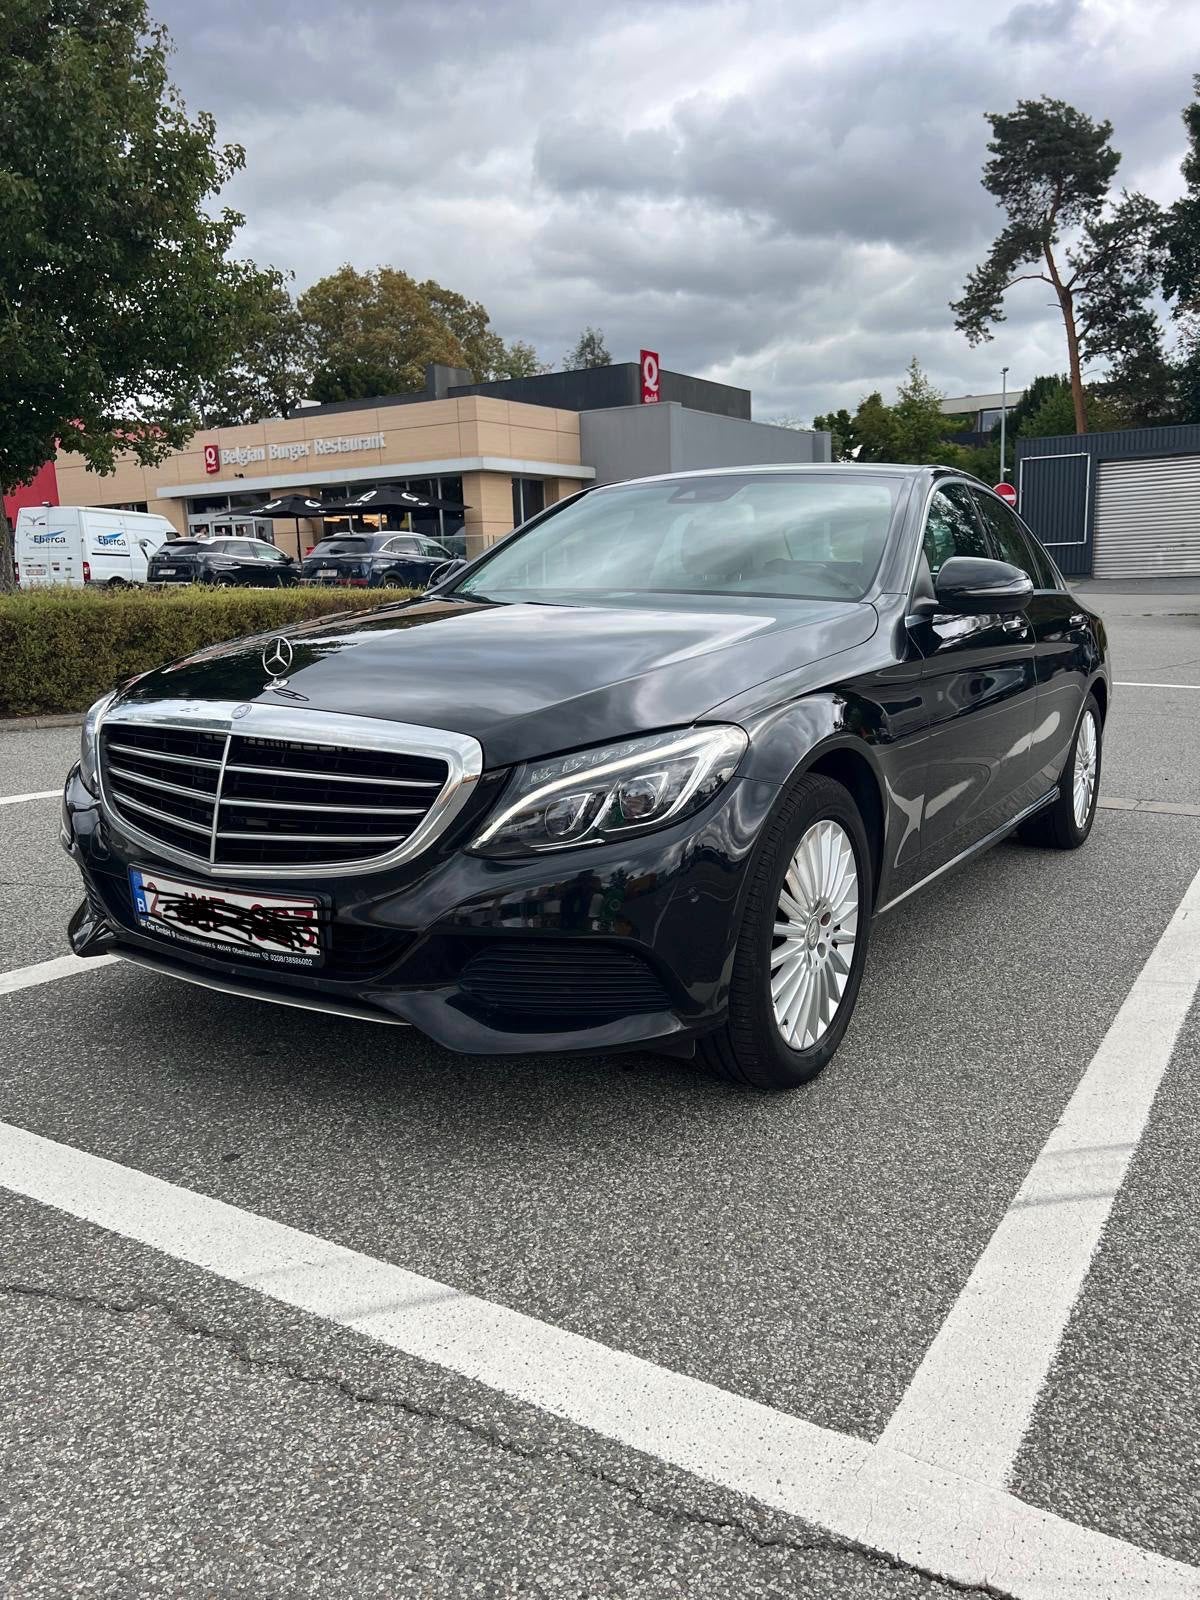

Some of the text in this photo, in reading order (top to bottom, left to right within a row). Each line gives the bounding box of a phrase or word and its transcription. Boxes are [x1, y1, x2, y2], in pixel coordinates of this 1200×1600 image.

[643, 356, 659, 392] Q
[206, 447, 216, 465] Q
[221, 432, 386, 466] Belgian Burger Restaurant
[33, 534, 66, 544] Eberca
[98, 535, 127, 547] Eberca
[136, 897, 146, 913] B
[232, 947, 261, 958] Oberhausen
